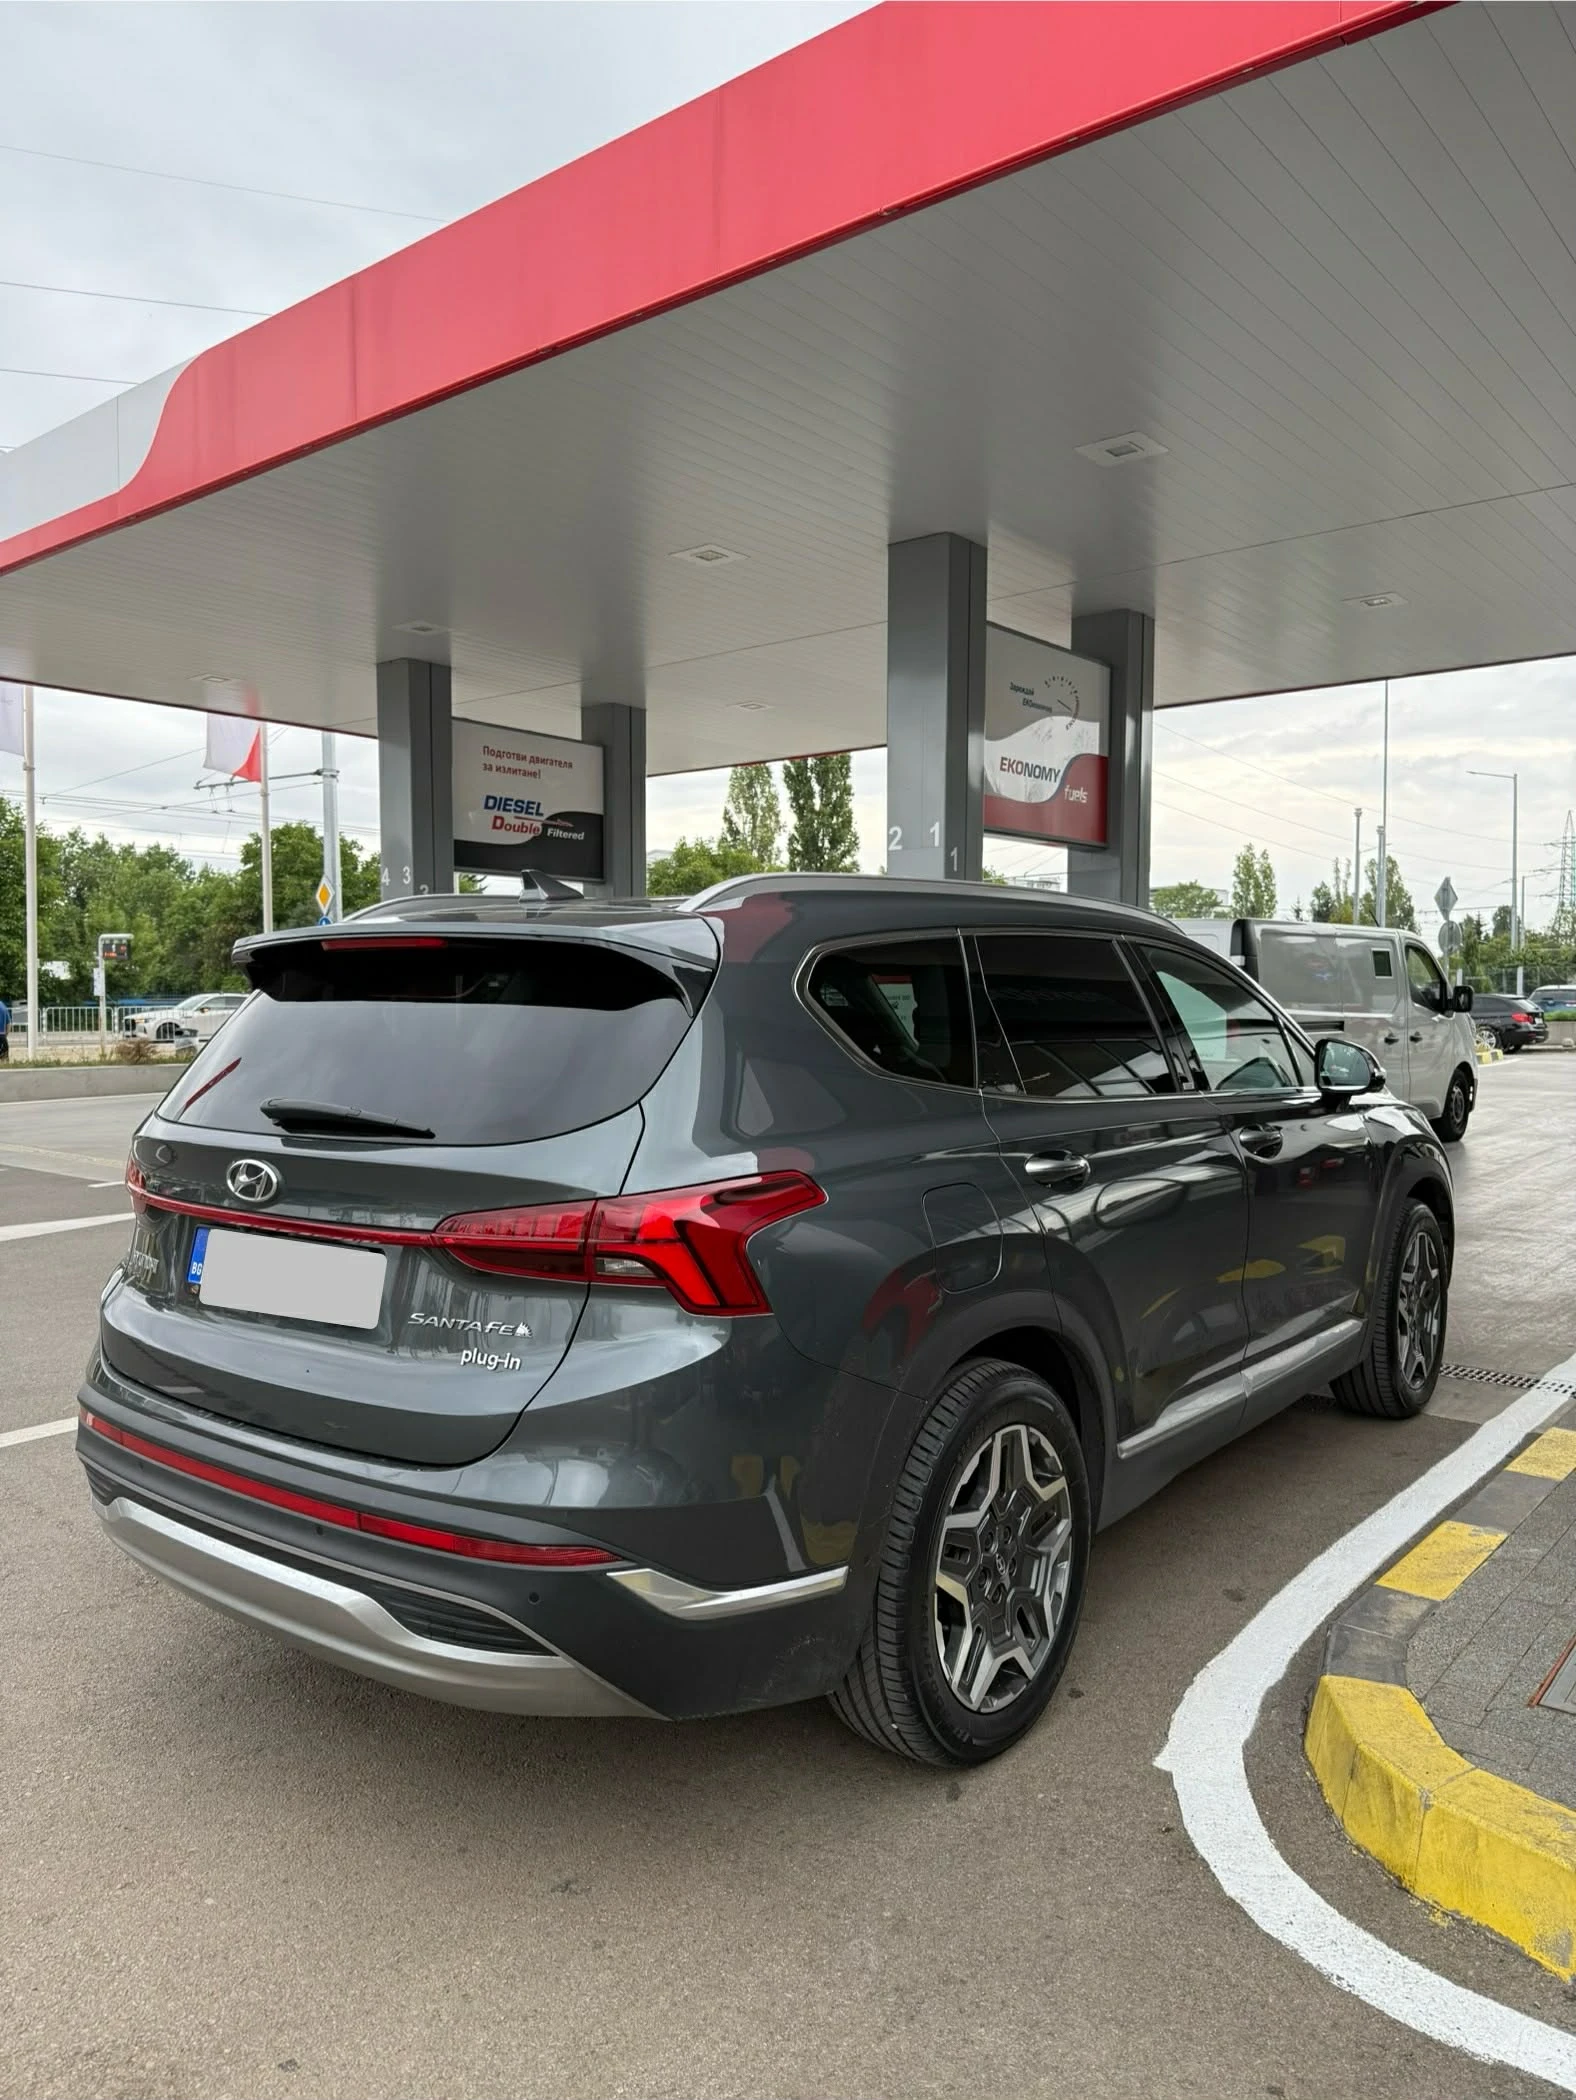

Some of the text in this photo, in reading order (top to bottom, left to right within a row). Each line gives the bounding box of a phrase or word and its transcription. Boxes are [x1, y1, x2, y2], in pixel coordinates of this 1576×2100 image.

[482, 745, 573, 769] Подготви двигателя
[482, 763, 541, 779] за излитане!
[1000, 756, 1061, 782] EKONOMY
[484, 795, 544, 817] DIESEL
[1064, 785, 1088, 804] fuels
[492, 815, 584, 840] Double Filtered
[888, 821, 940, 851] 2 1
[950, 847, 958, 872] 1
[381, 866, 411, 886] 4 3
[191, 1261, 203, 1275] BG
